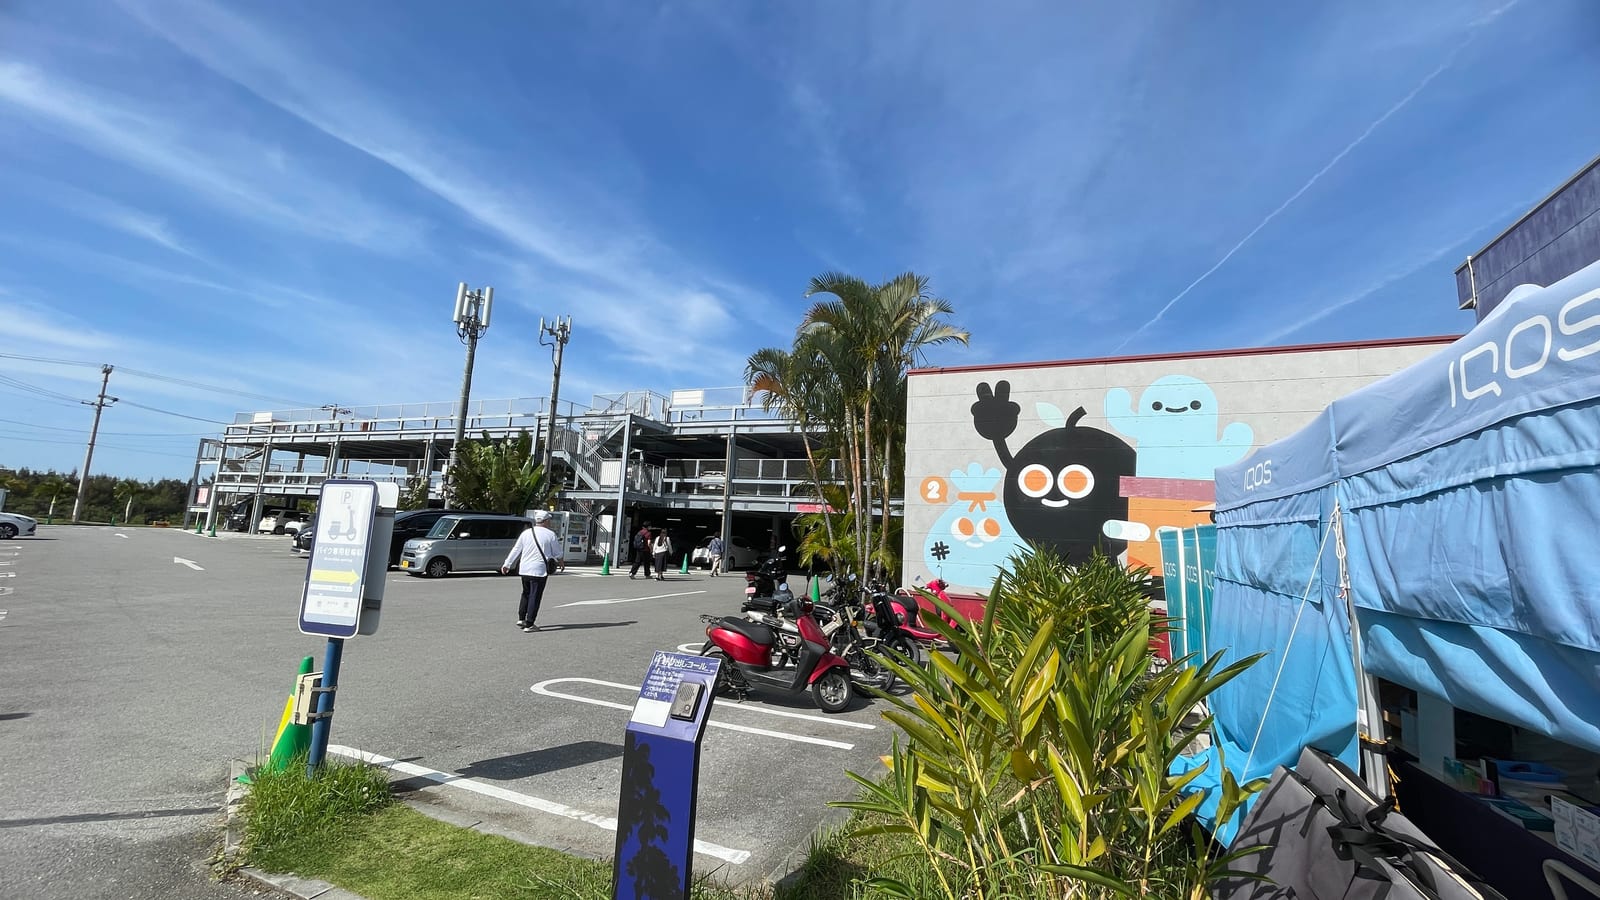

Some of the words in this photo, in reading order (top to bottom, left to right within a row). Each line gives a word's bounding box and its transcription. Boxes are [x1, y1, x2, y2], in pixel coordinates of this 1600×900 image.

[1449, 287, 1600, 408] IQOS
[1244, 459, 1271, 492] IQOS
[344, 492, 351, 502] P
[927, 481, 940, 499] 2
